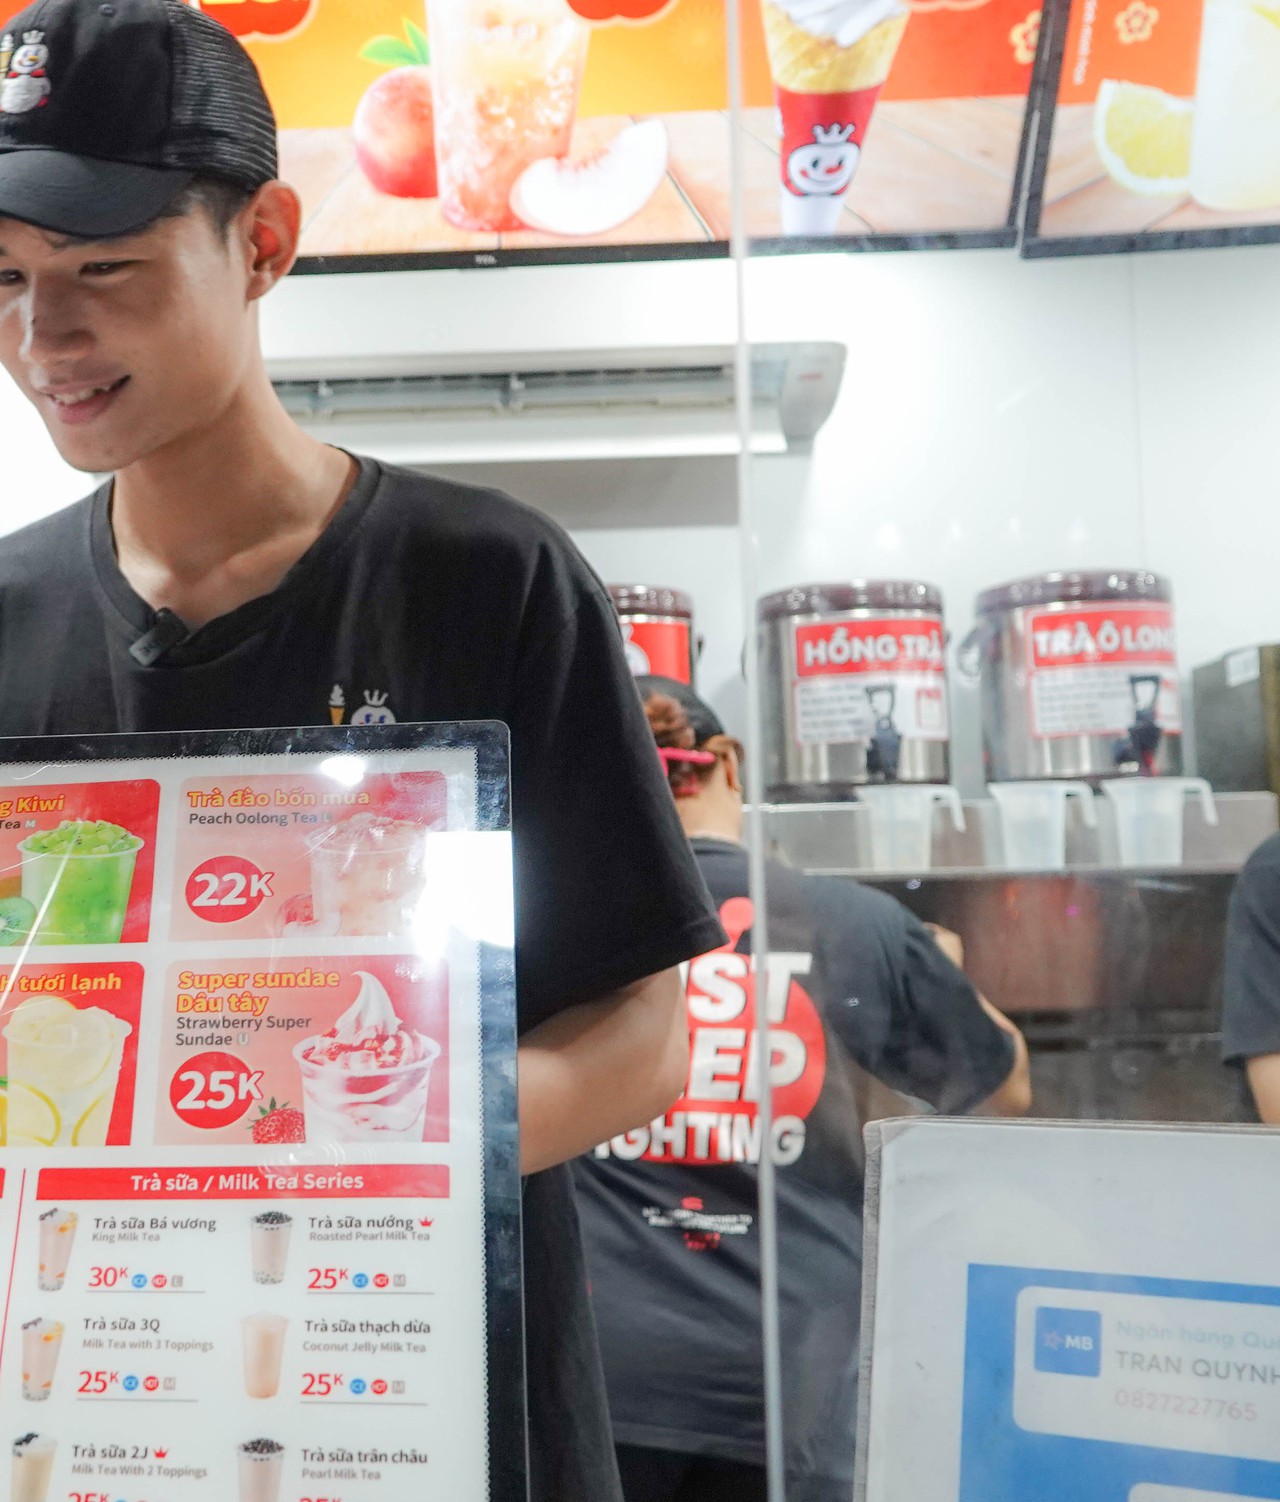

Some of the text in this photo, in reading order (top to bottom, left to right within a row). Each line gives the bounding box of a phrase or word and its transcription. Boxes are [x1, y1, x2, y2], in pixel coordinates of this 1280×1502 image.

[16, 794, 66, 814] Kiwi
[186, 787, 225, 808] Trà
[228, 786, 270, 808] đào
[274, 787, 317, 807] bốn
[189, 811, 317, 826] Peach Oolong Tea
[191, 872, 274, 908] 22K
[19, 974, 65, 992] tươi
[71, 973, 122, 995] lạnh
[178, 968, 340, 992] Super sundae
[177, 991, 269, 1016] Dâu tây
[177, 1016, 312, 1031] Strawberry Super
[175, 1033, 233, 1046] Sundae
[176, 1070, 264, 1110] 25K
[131, 1174, 162, 1191] Trà
[165, 1172, 198, 1191] sữa
[219, 1174, 260, 1190] Milk
[265, 1174, 298, 1190] Tea
[303, 1173, 364, 1189] Series
[308, 1215, 414, 1231] Trà sữa nướng
[308, 1268, 348, 1290] 25K
[303, 1341, 426, 1354] Coconut Jelly Milk Tea
[1065, 1335, 1094, 1351] MB
[1115, 1350, 1183, 1375] TRAN
